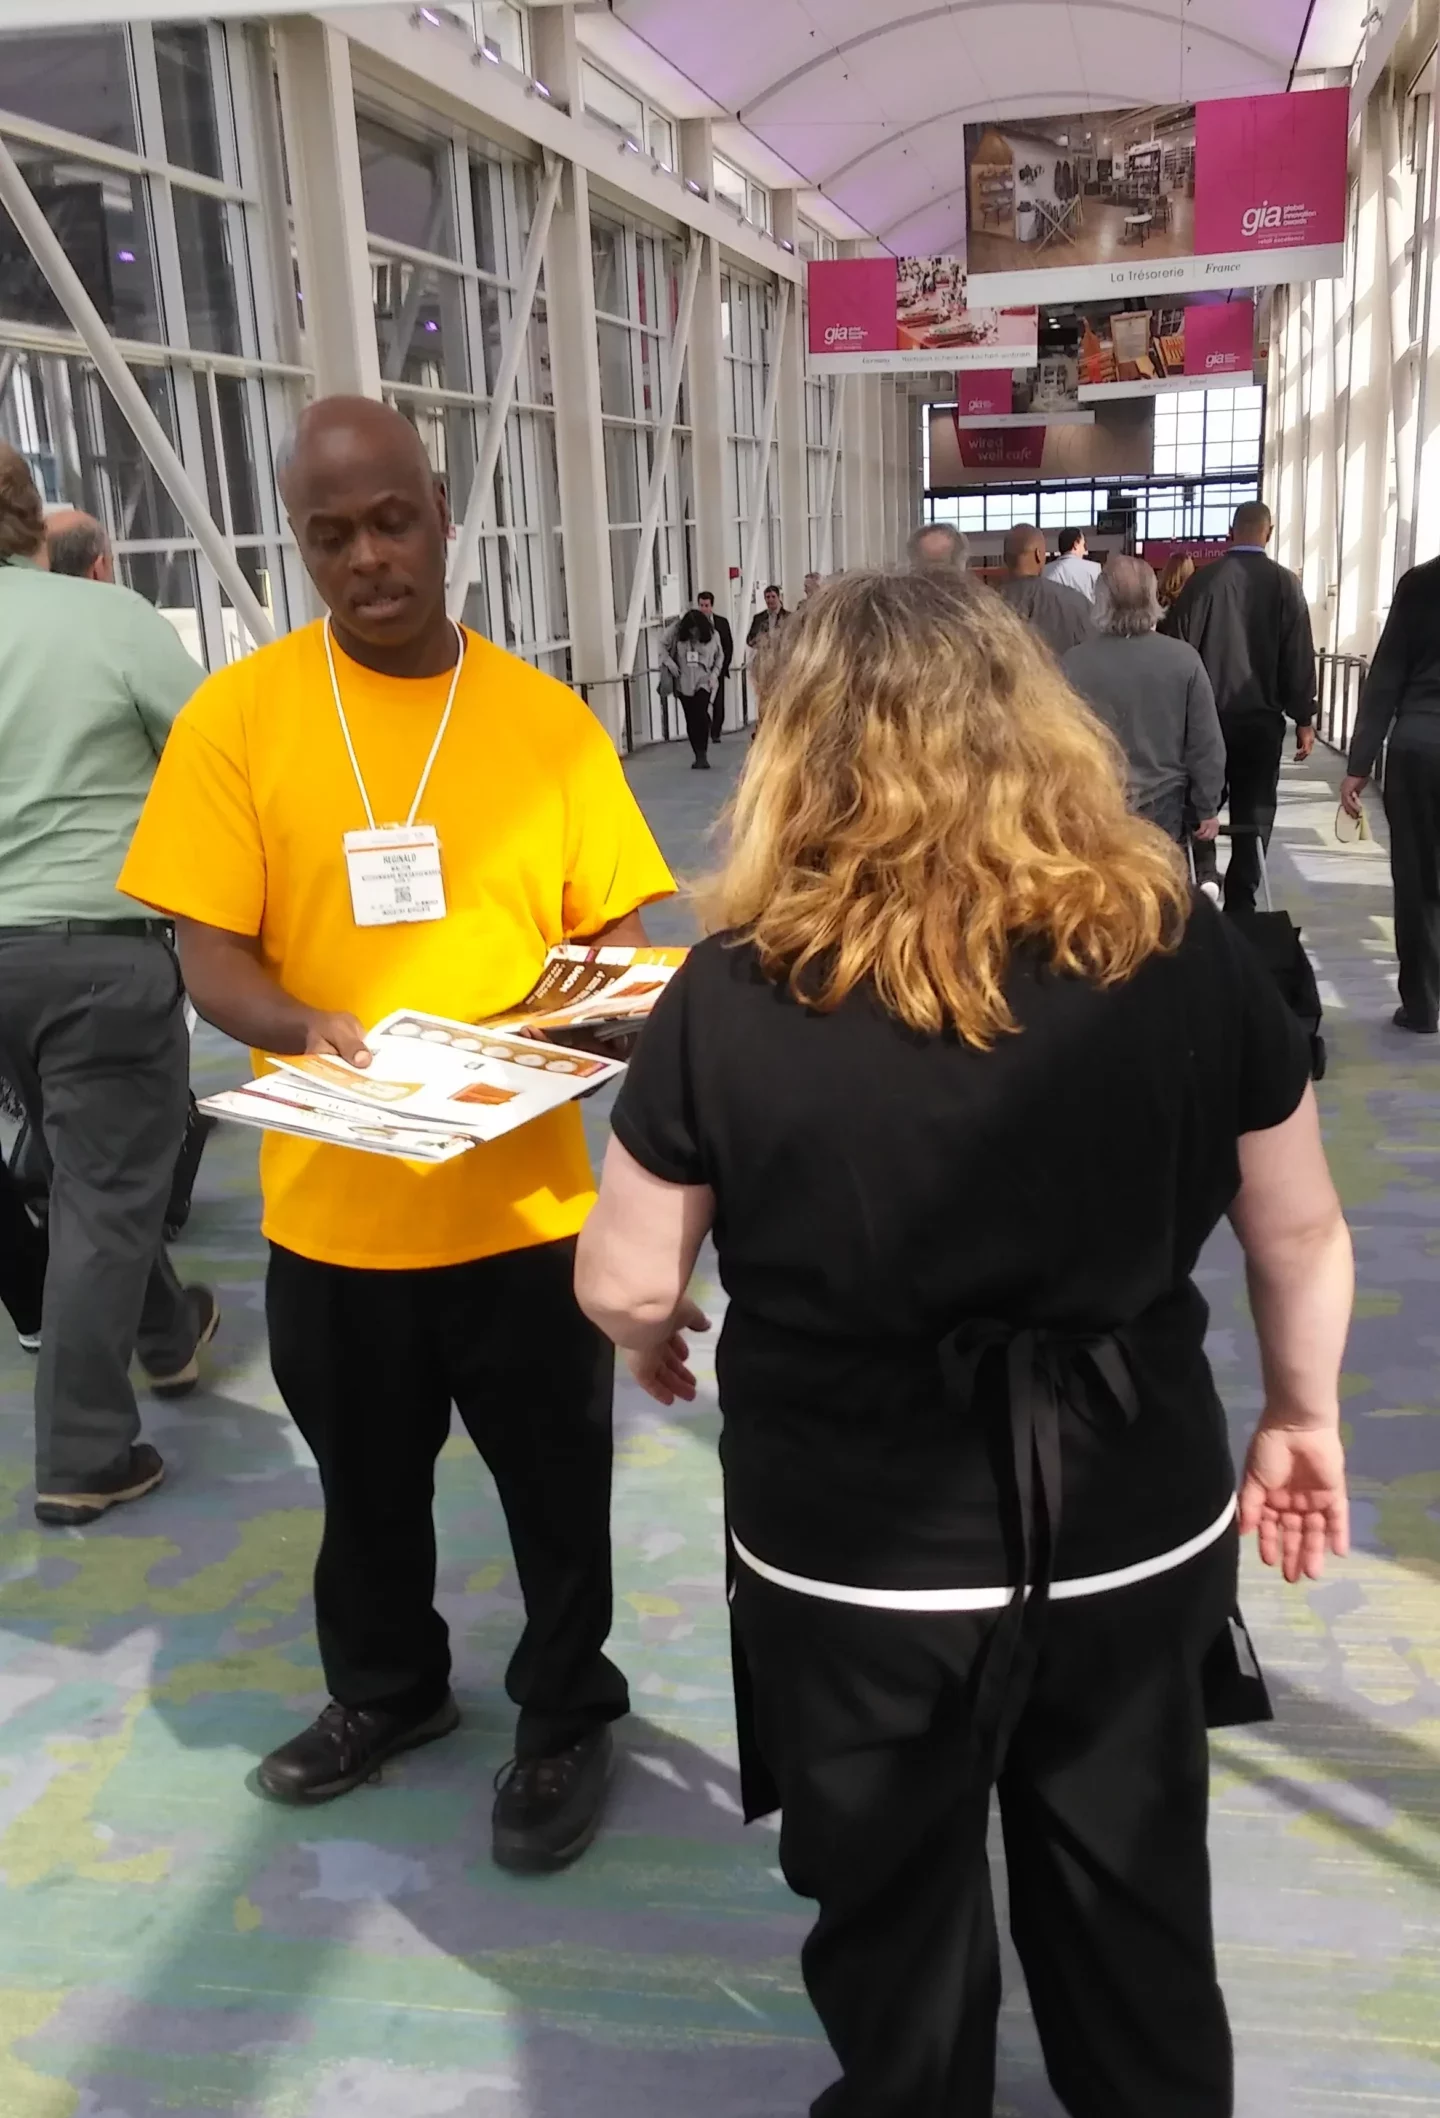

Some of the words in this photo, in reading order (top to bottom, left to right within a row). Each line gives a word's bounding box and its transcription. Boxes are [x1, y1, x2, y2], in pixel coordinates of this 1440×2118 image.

[1241, 200, 1282, 236] gia
[1111, 272, 1124, 283] La
[1129, 266, 1184, 281] Trésorerie
[1205, 263, 1241, 274] France
[824, 323, 848, 345] gia
[1205, 351, 1224, 368] gia
[968, 435, 1004, 449] wired
[976, 448, 1004, 462] well
[383, 853, 417, 864] REGINALD
